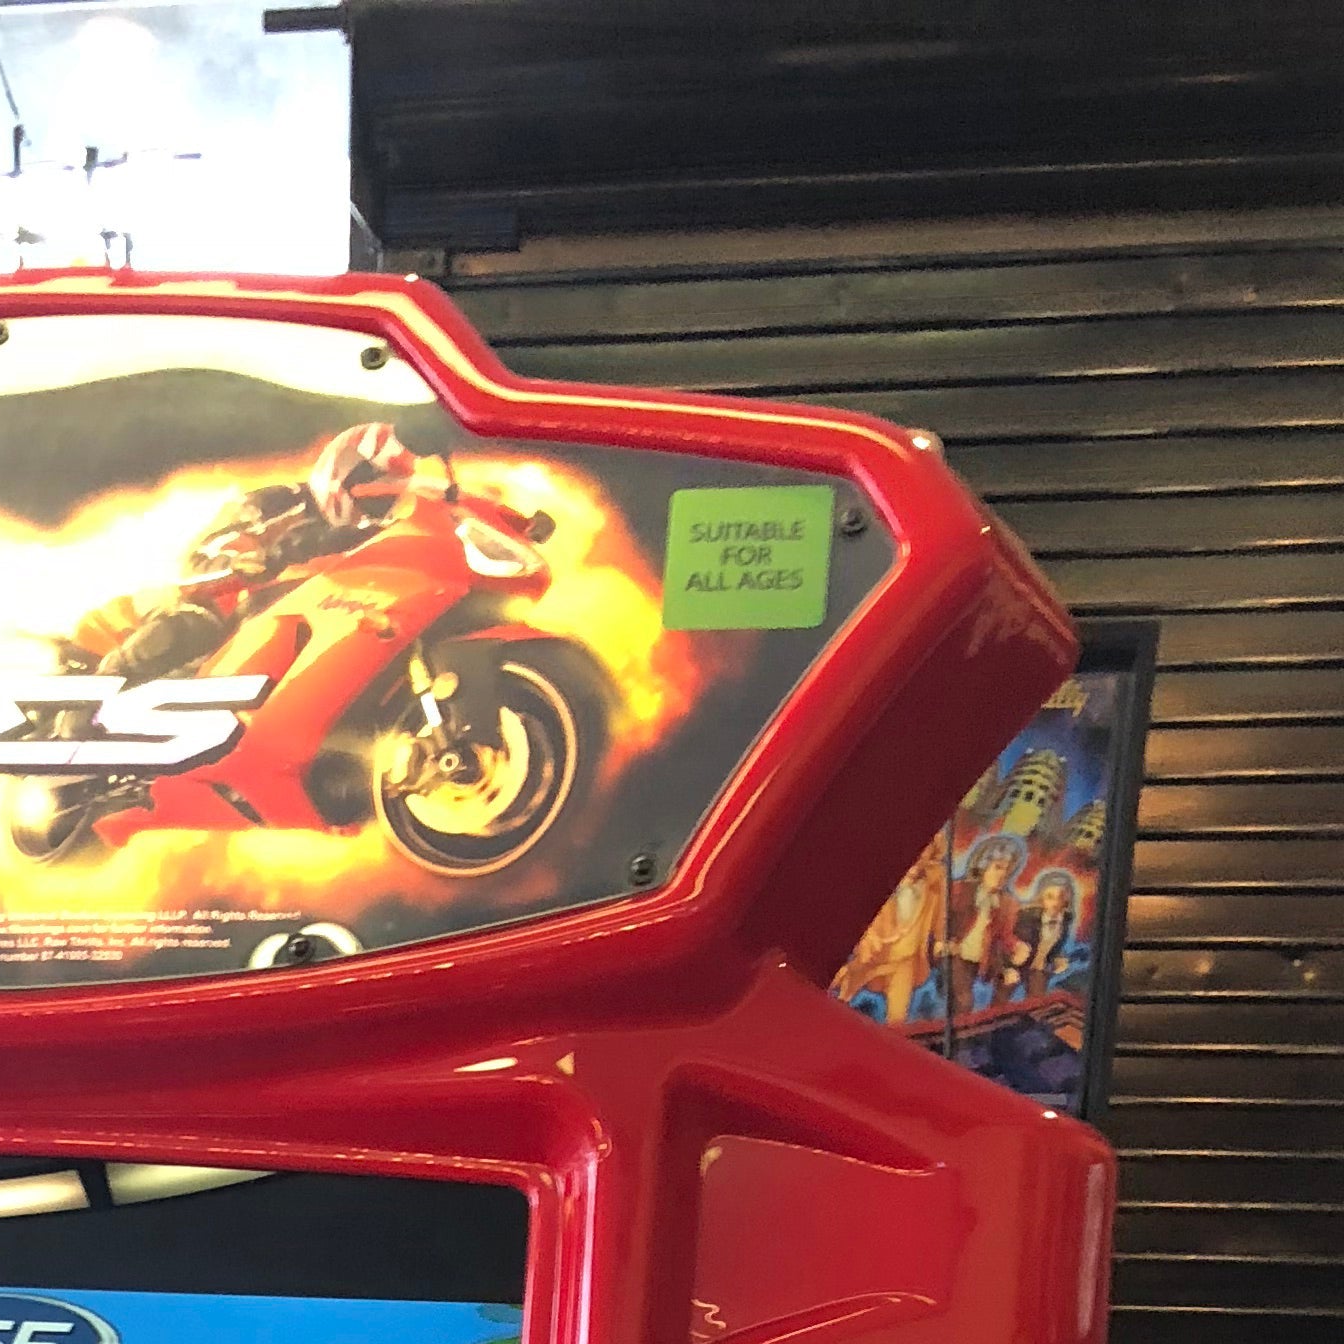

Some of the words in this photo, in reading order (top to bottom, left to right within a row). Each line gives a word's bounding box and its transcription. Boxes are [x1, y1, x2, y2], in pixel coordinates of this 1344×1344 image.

[689, 519, 805, 543] SUITABLE
[720, 546, 772, 566] FOR
[685, 571, 731, 592] ALL
[736, 569, 804, 591] AGES
